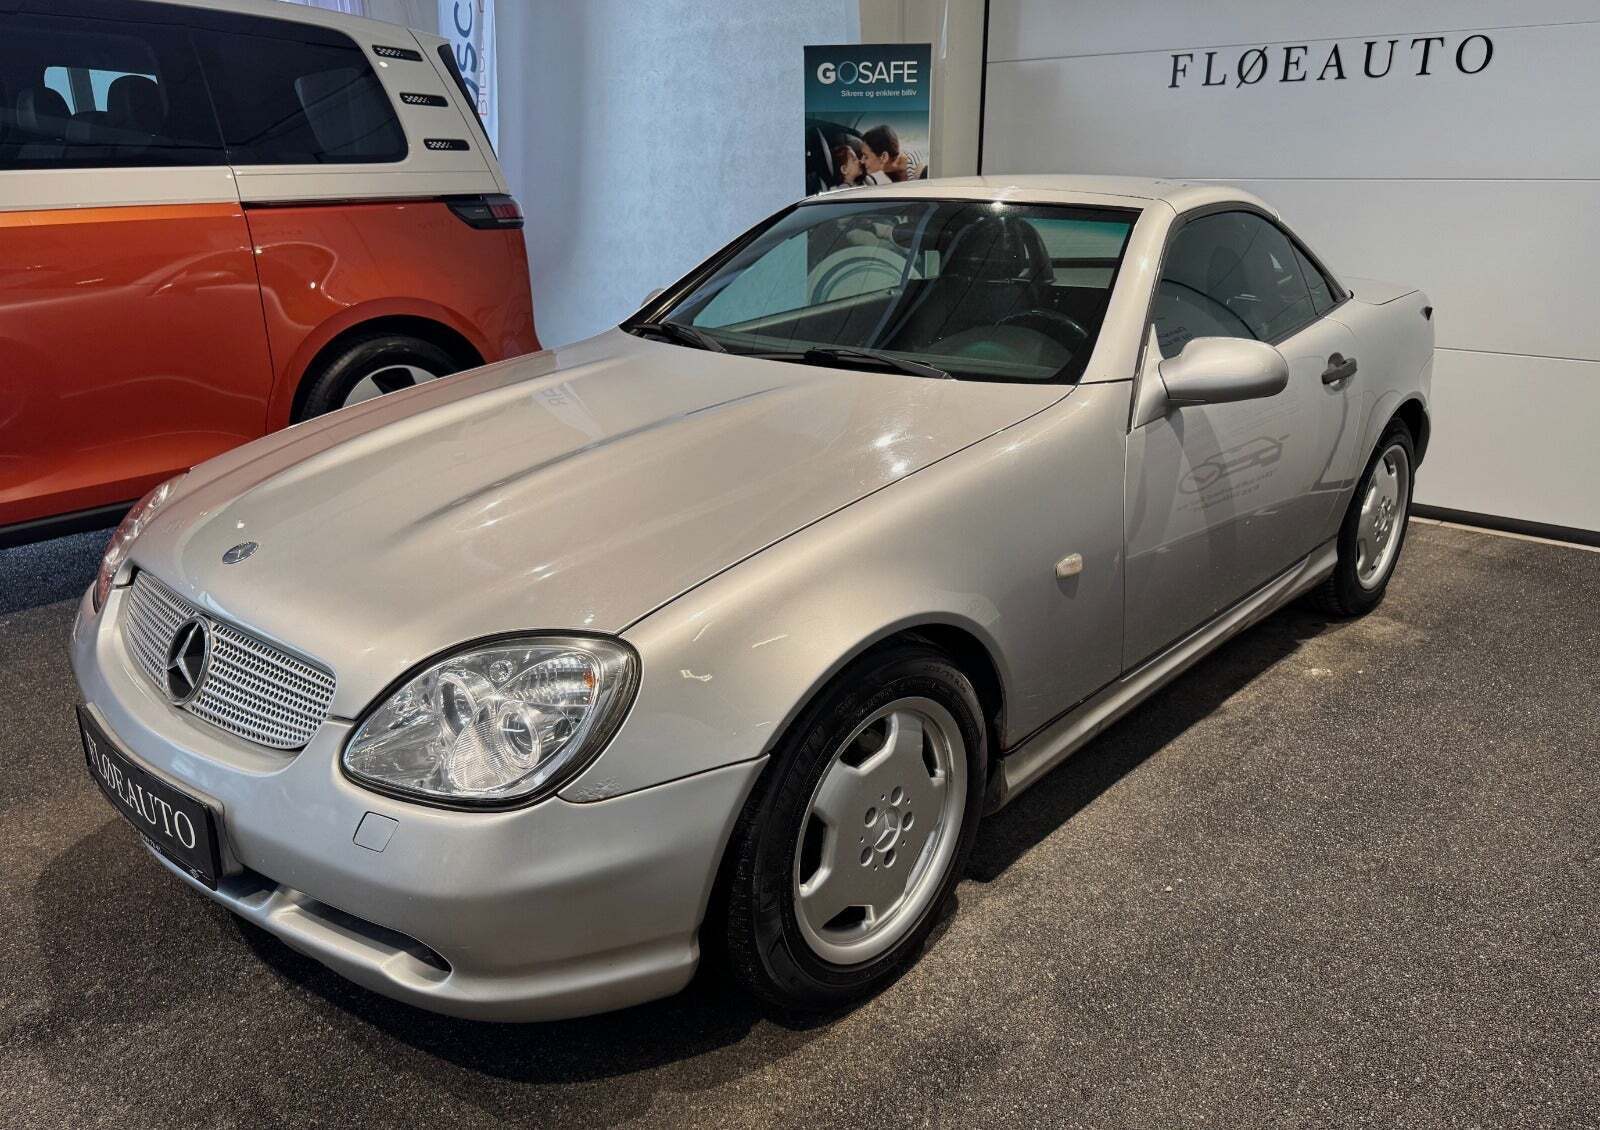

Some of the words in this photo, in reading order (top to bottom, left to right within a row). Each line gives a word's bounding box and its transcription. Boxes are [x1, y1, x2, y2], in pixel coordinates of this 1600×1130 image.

[817, 61, 918, 85] GOSAFE
[1168, 34, 1495, 89] FLØEAUTO
[865, 90, 875, 98] og
[85, 730, 197, 850] FLØEAUTO
